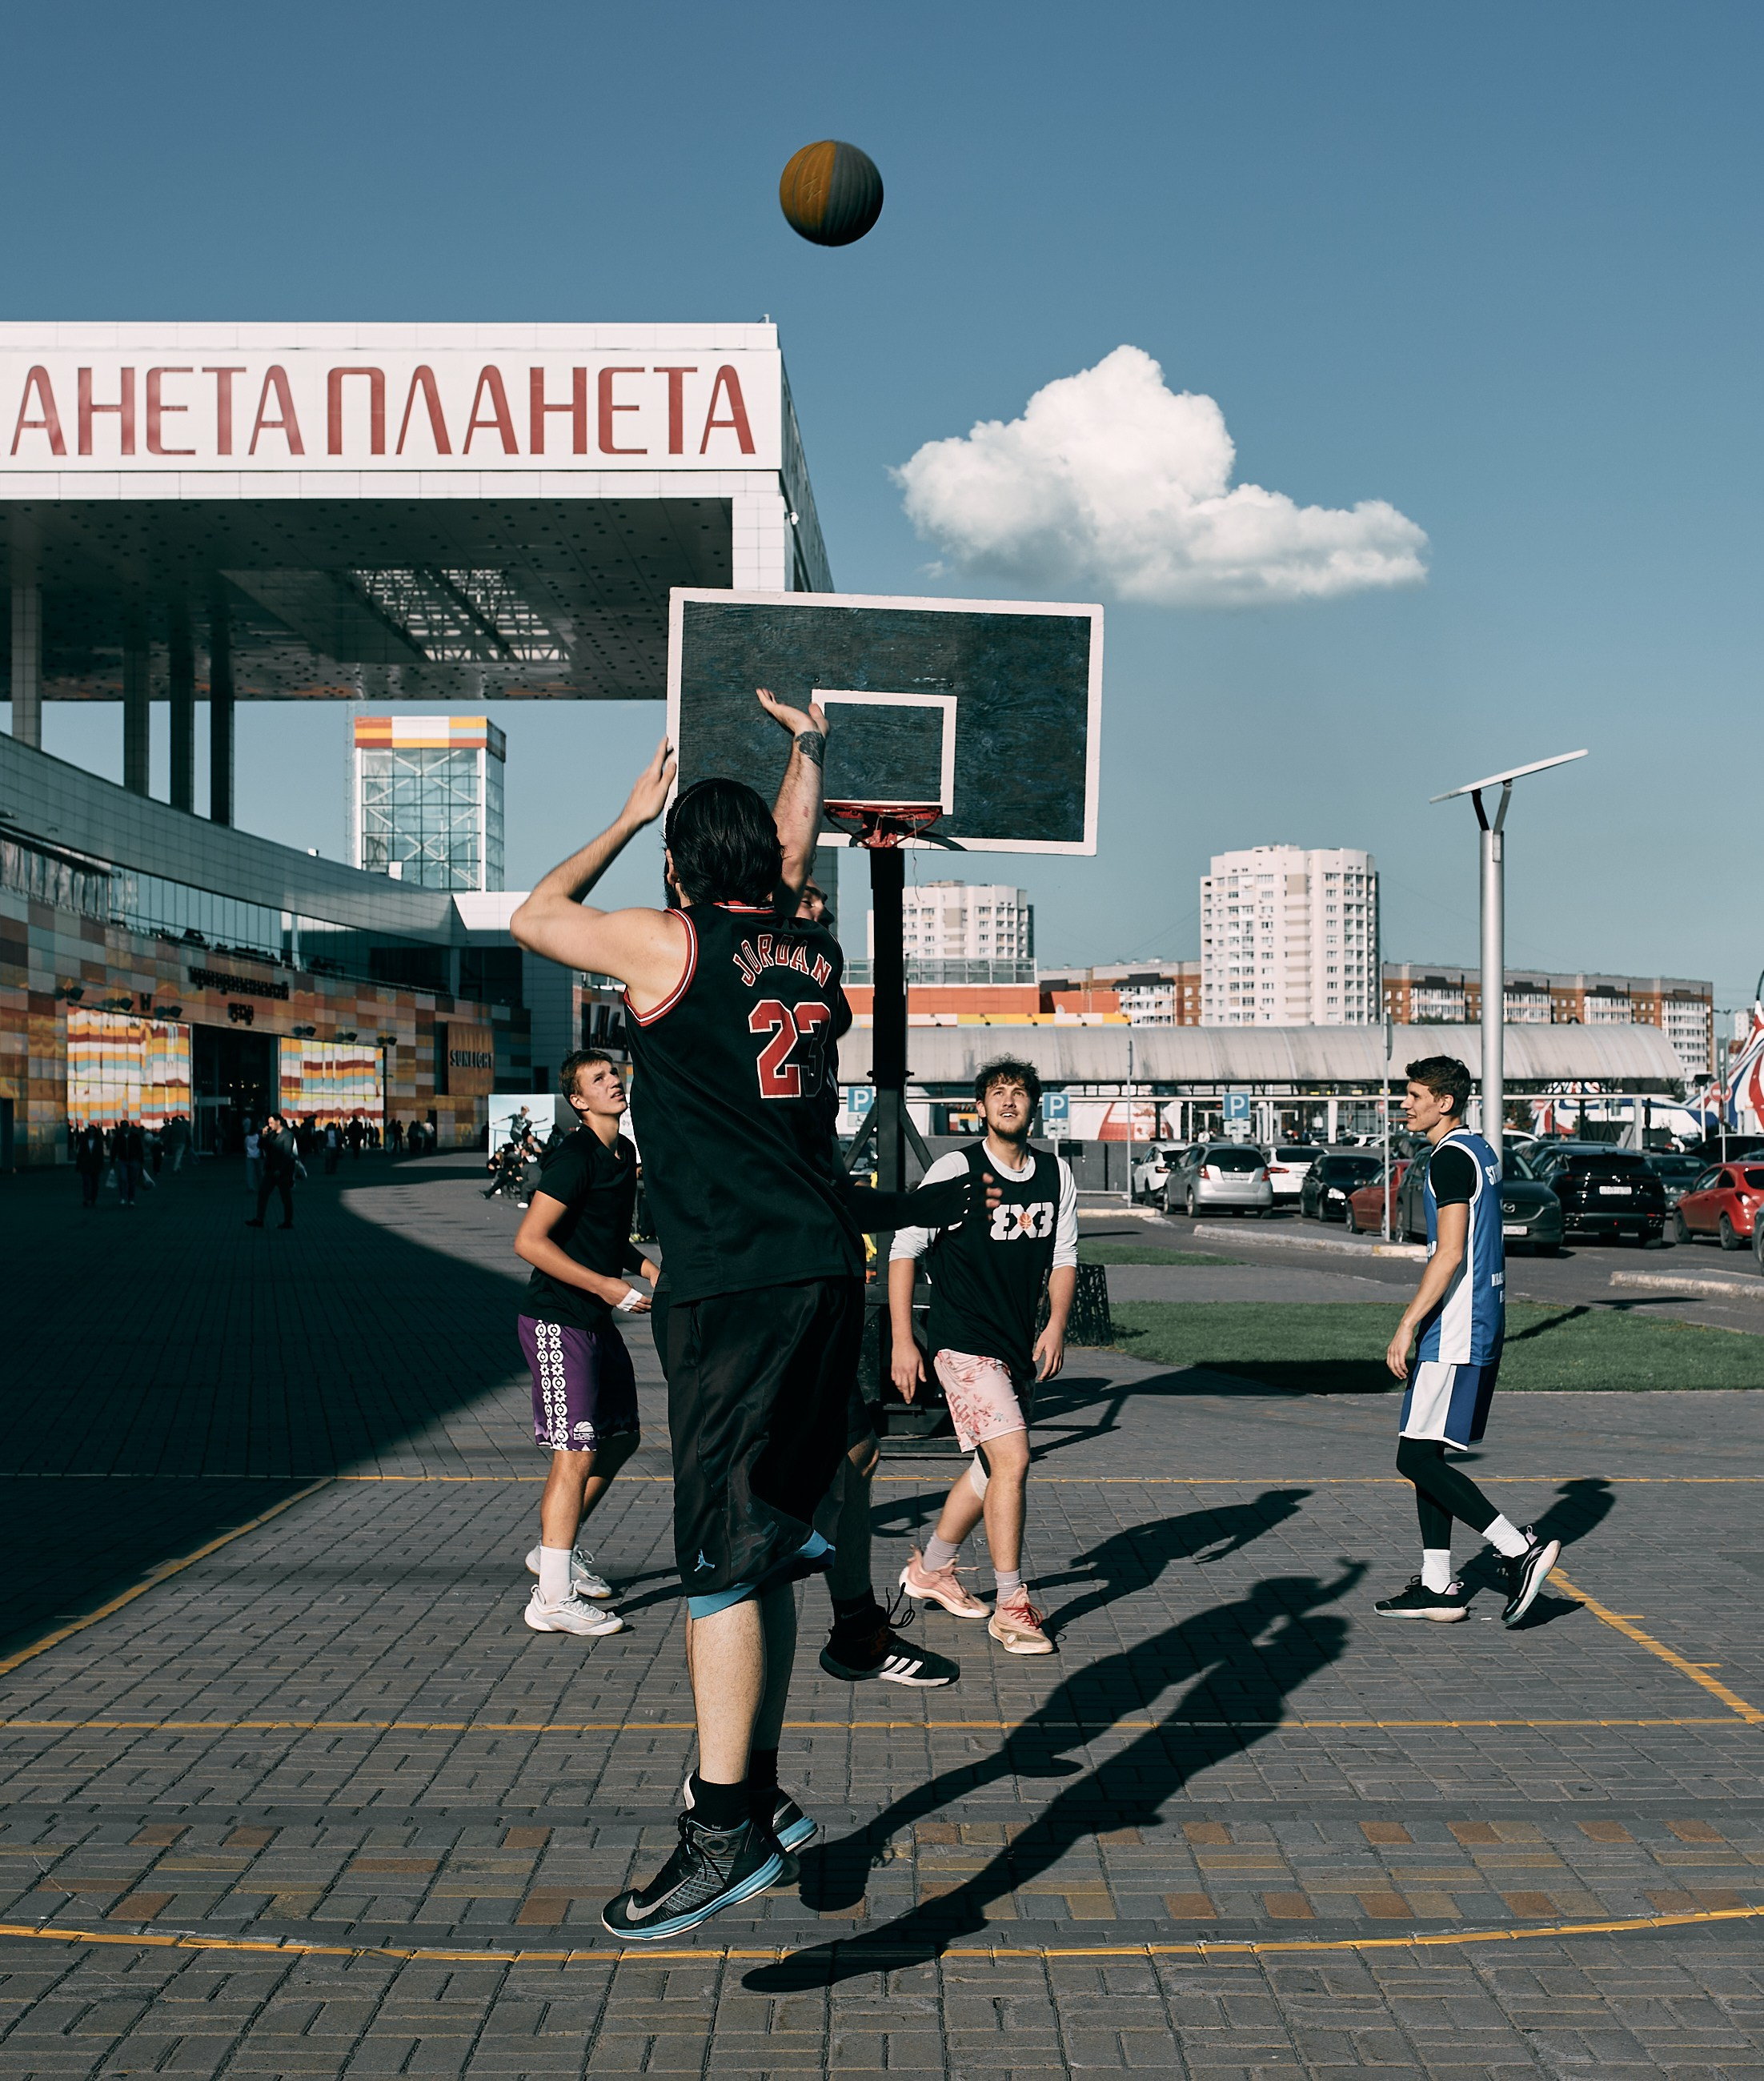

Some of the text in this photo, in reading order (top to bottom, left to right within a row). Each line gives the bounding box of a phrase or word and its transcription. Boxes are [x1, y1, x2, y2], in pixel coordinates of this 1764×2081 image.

[327, 364, 756, 455] ПЛАНЕТА
[733, 933, 832, 988] JORDAN
[450, 1049, 494, 1069] SUNLIGHT
[748, 999, 832, 1099] 23
[854, 1089, 869, 1111] P
[1049, 1096, 1065, 1117] P
[1230, 1095, 1245, 1117] P
